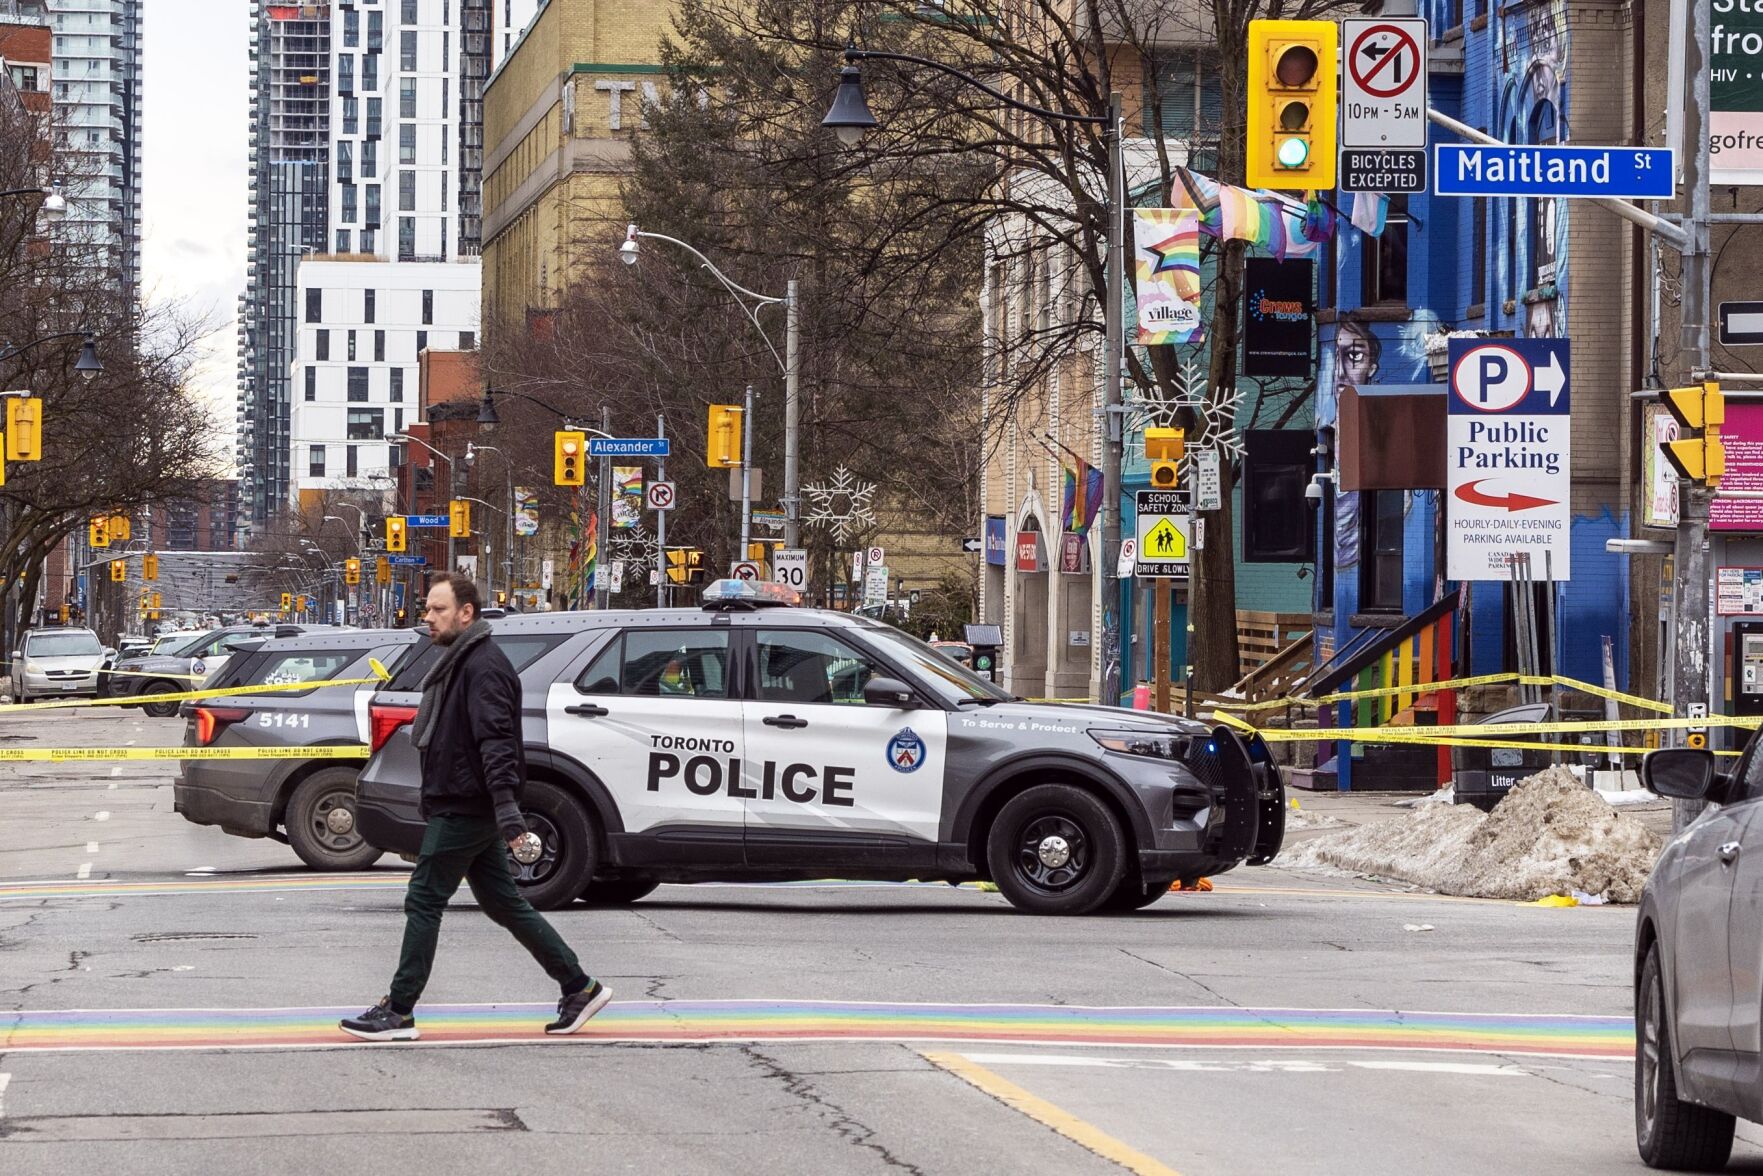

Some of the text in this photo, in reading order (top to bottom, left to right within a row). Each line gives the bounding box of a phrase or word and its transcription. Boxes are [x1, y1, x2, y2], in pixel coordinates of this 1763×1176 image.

[1710, 69, 1738, 82] HIV
[1351, 155, 1416, 169] BICYCLES
[1458, 150, 1652, 183] Maitland St
[1349, 173, 1417, 187] EXCEPTED
[1148, 306, 1192, 321] village
[1480, 355, 1508, 402] P
[1468, 421, 1548, 443] Public
[594, 441, 654, 452] Alexander
[1457, 446, 1560, 474] Parking
[1148, 494, 1182, 503] SCHOOL
[1138, 504, 1167, 512] SAFETY
[1454, 519, 1562, 529] HOURLY-DAILY-EVENING
[1463, 534, 1552, 544] PARKING AVAILABLE
[778, 567, 803, 585] 30
[1137, 565, 1159, 573] DRIVE
[260, 712, 310, 728] 5141
[962, 719, 976, 728] To
[979, 720, 1015, 730] Serve
[1031, 723, 1076, 733] Protect
[650, 734, 735, 753] TORONTO
[646, 752, 856, 807] POLICE
[1491, 774, 1515, 786] Litter
